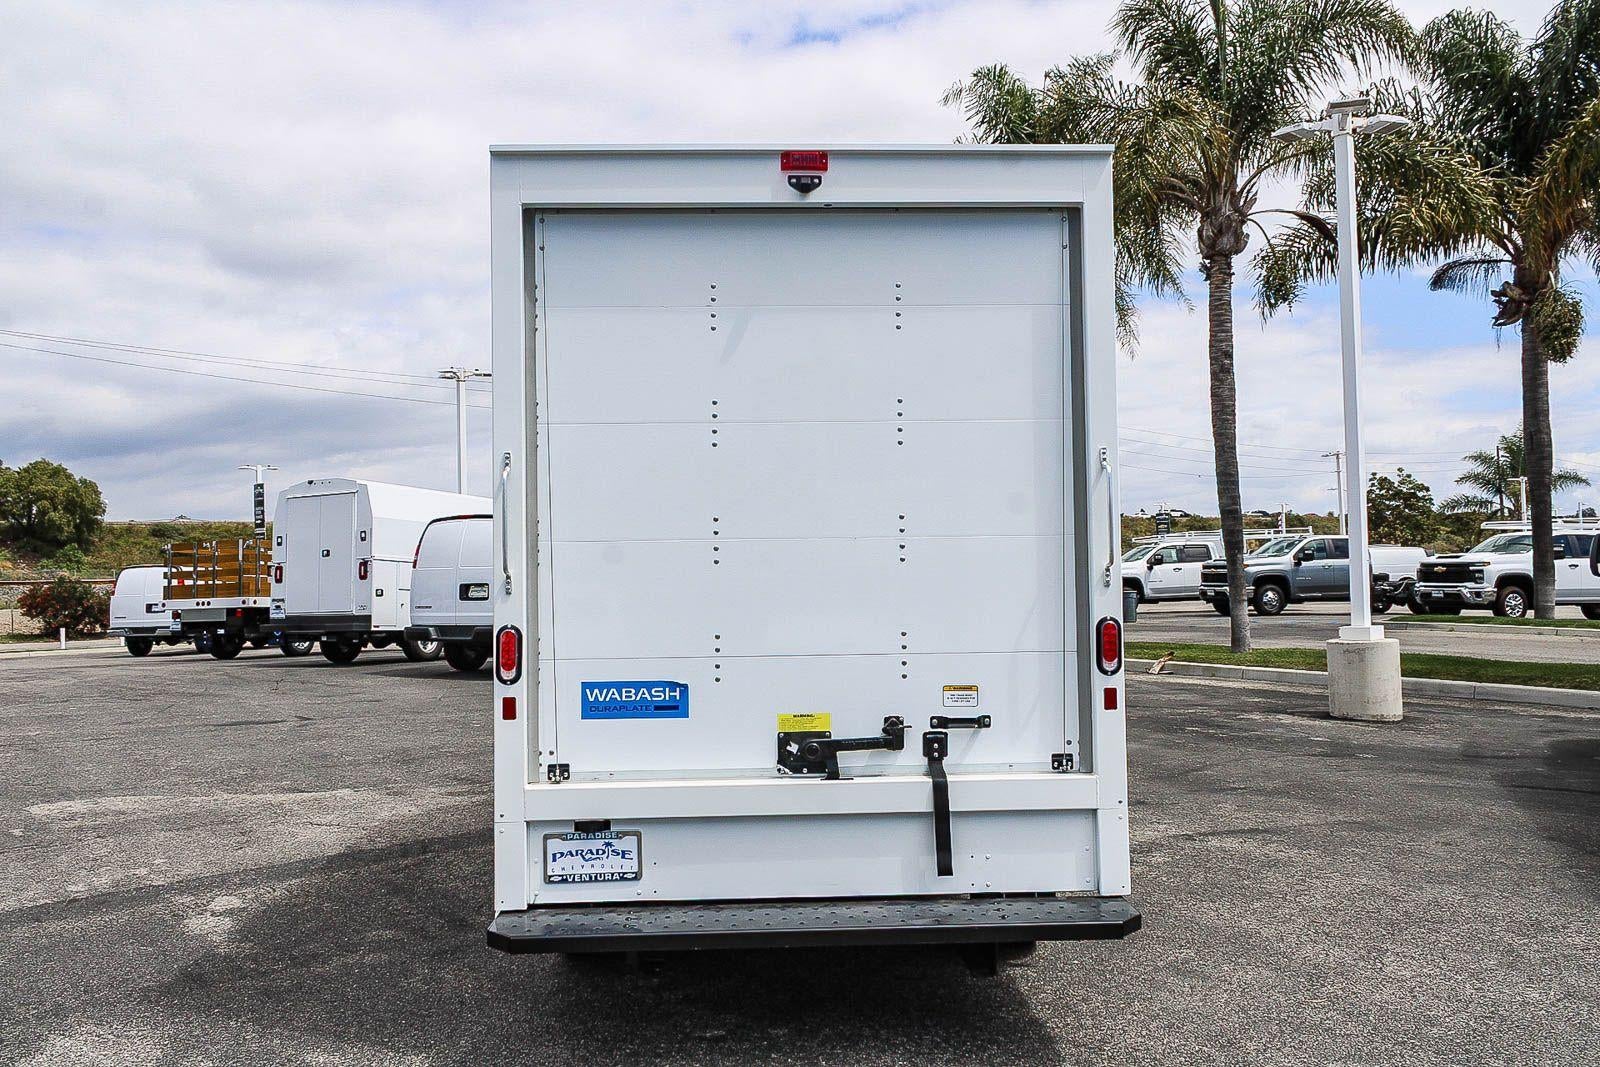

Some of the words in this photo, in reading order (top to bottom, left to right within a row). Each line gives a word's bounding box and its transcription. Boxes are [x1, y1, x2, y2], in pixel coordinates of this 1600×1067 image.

[585, 687, 680, 702] WABASH
[589, 704, 652, 713] DURAPLATE
[566, 831, 618, 840] PARADISE
[551, 844, 634, 863] PARADISE
[551, 863, 634, 874] CHEVROLET
[566, 872, 621, 882] VENTURA
